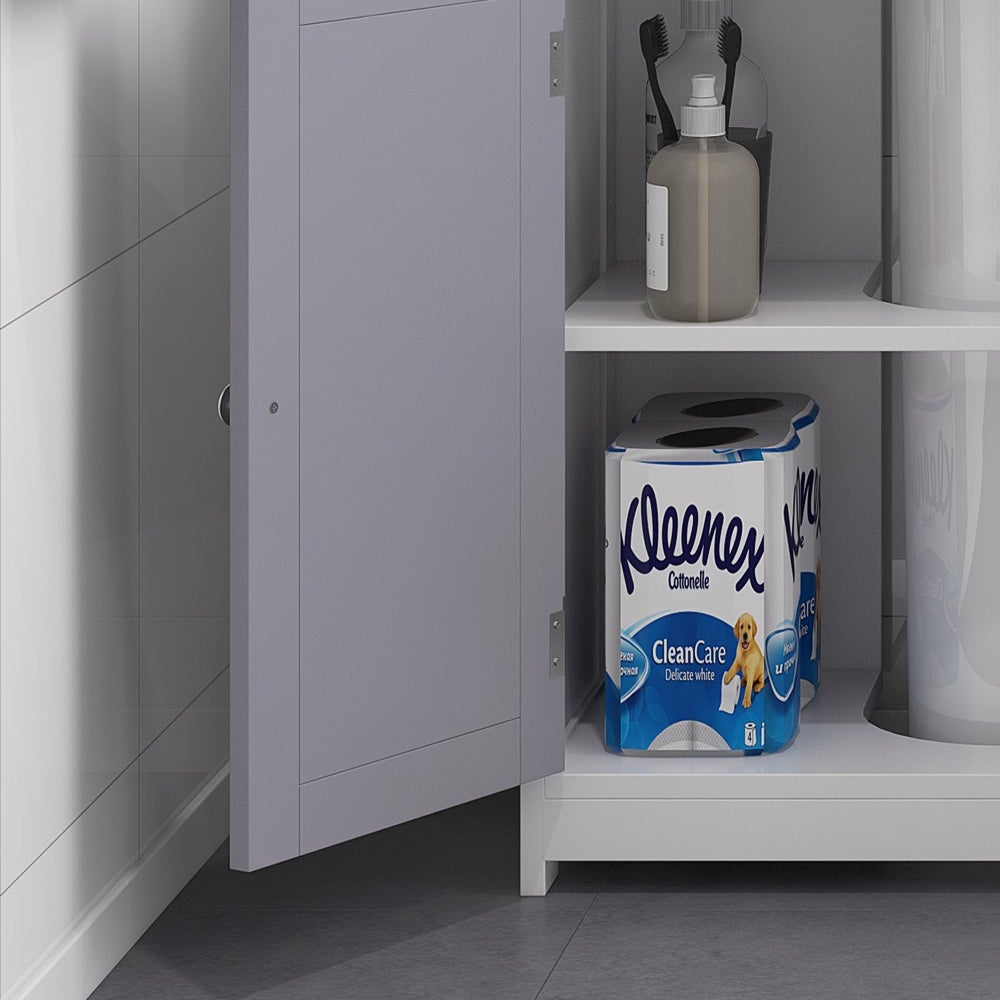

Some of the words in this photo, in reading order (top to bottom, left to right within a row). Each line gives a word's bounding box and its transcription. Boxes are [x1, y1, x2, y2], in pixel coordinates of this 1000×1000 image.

[620, 483, 764, 595] Kleenex
[668, 570, 710, 590] Cottonelle
[652, 638, 726, 664] CleanCare
[665, 668, 694, 681] Delicate
[694, 668, 715, 681] white
